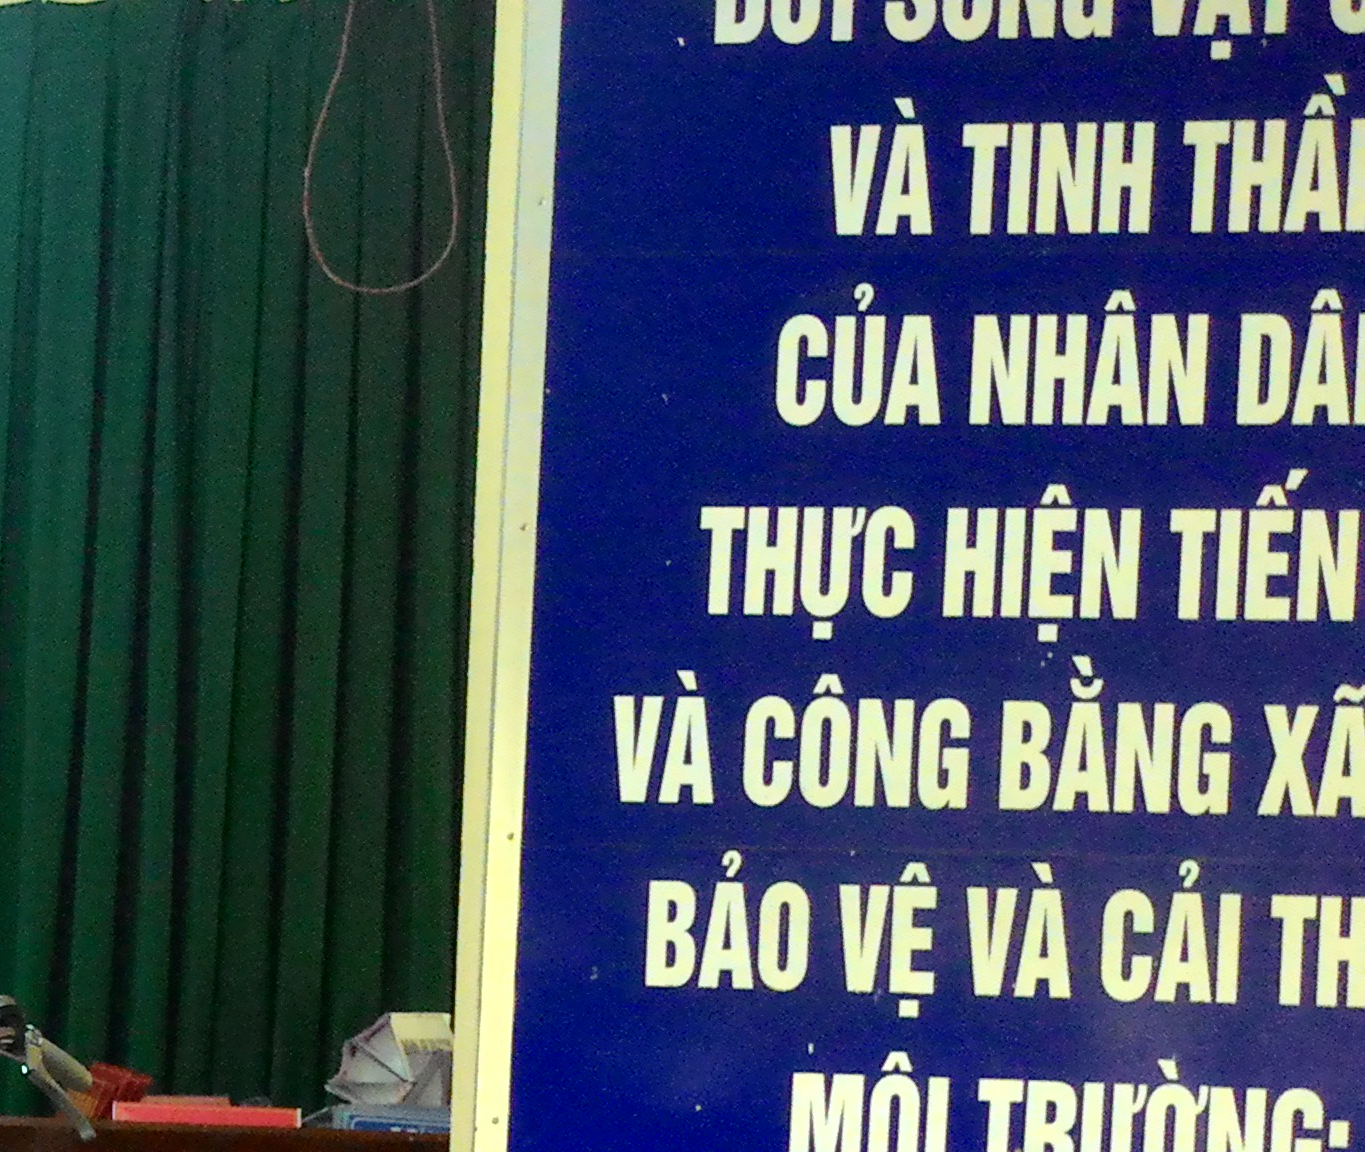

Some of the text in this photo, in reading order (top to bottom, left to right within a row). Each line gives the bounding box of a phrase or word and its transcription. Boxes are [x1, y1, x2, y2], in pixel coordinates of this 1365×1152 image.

[831, 98, 932, 235] VÀ
[963, 121, 1155, 235] TINH
[776, 283, 1365, 426] CỦA NHÂN DÂ
[700, 468, 1360, 642] THỰC HIỆN TIẾN
[614, 655, 1365, 817] VÀ CÔNG BẰNG XÃ
[645, 850, 811, 992] BẢO
[839, 862, 937, 1018] VỆ
[967, 862, 1071, 999] VÀ
[1101, 859, 1242, 1004] CẢI
